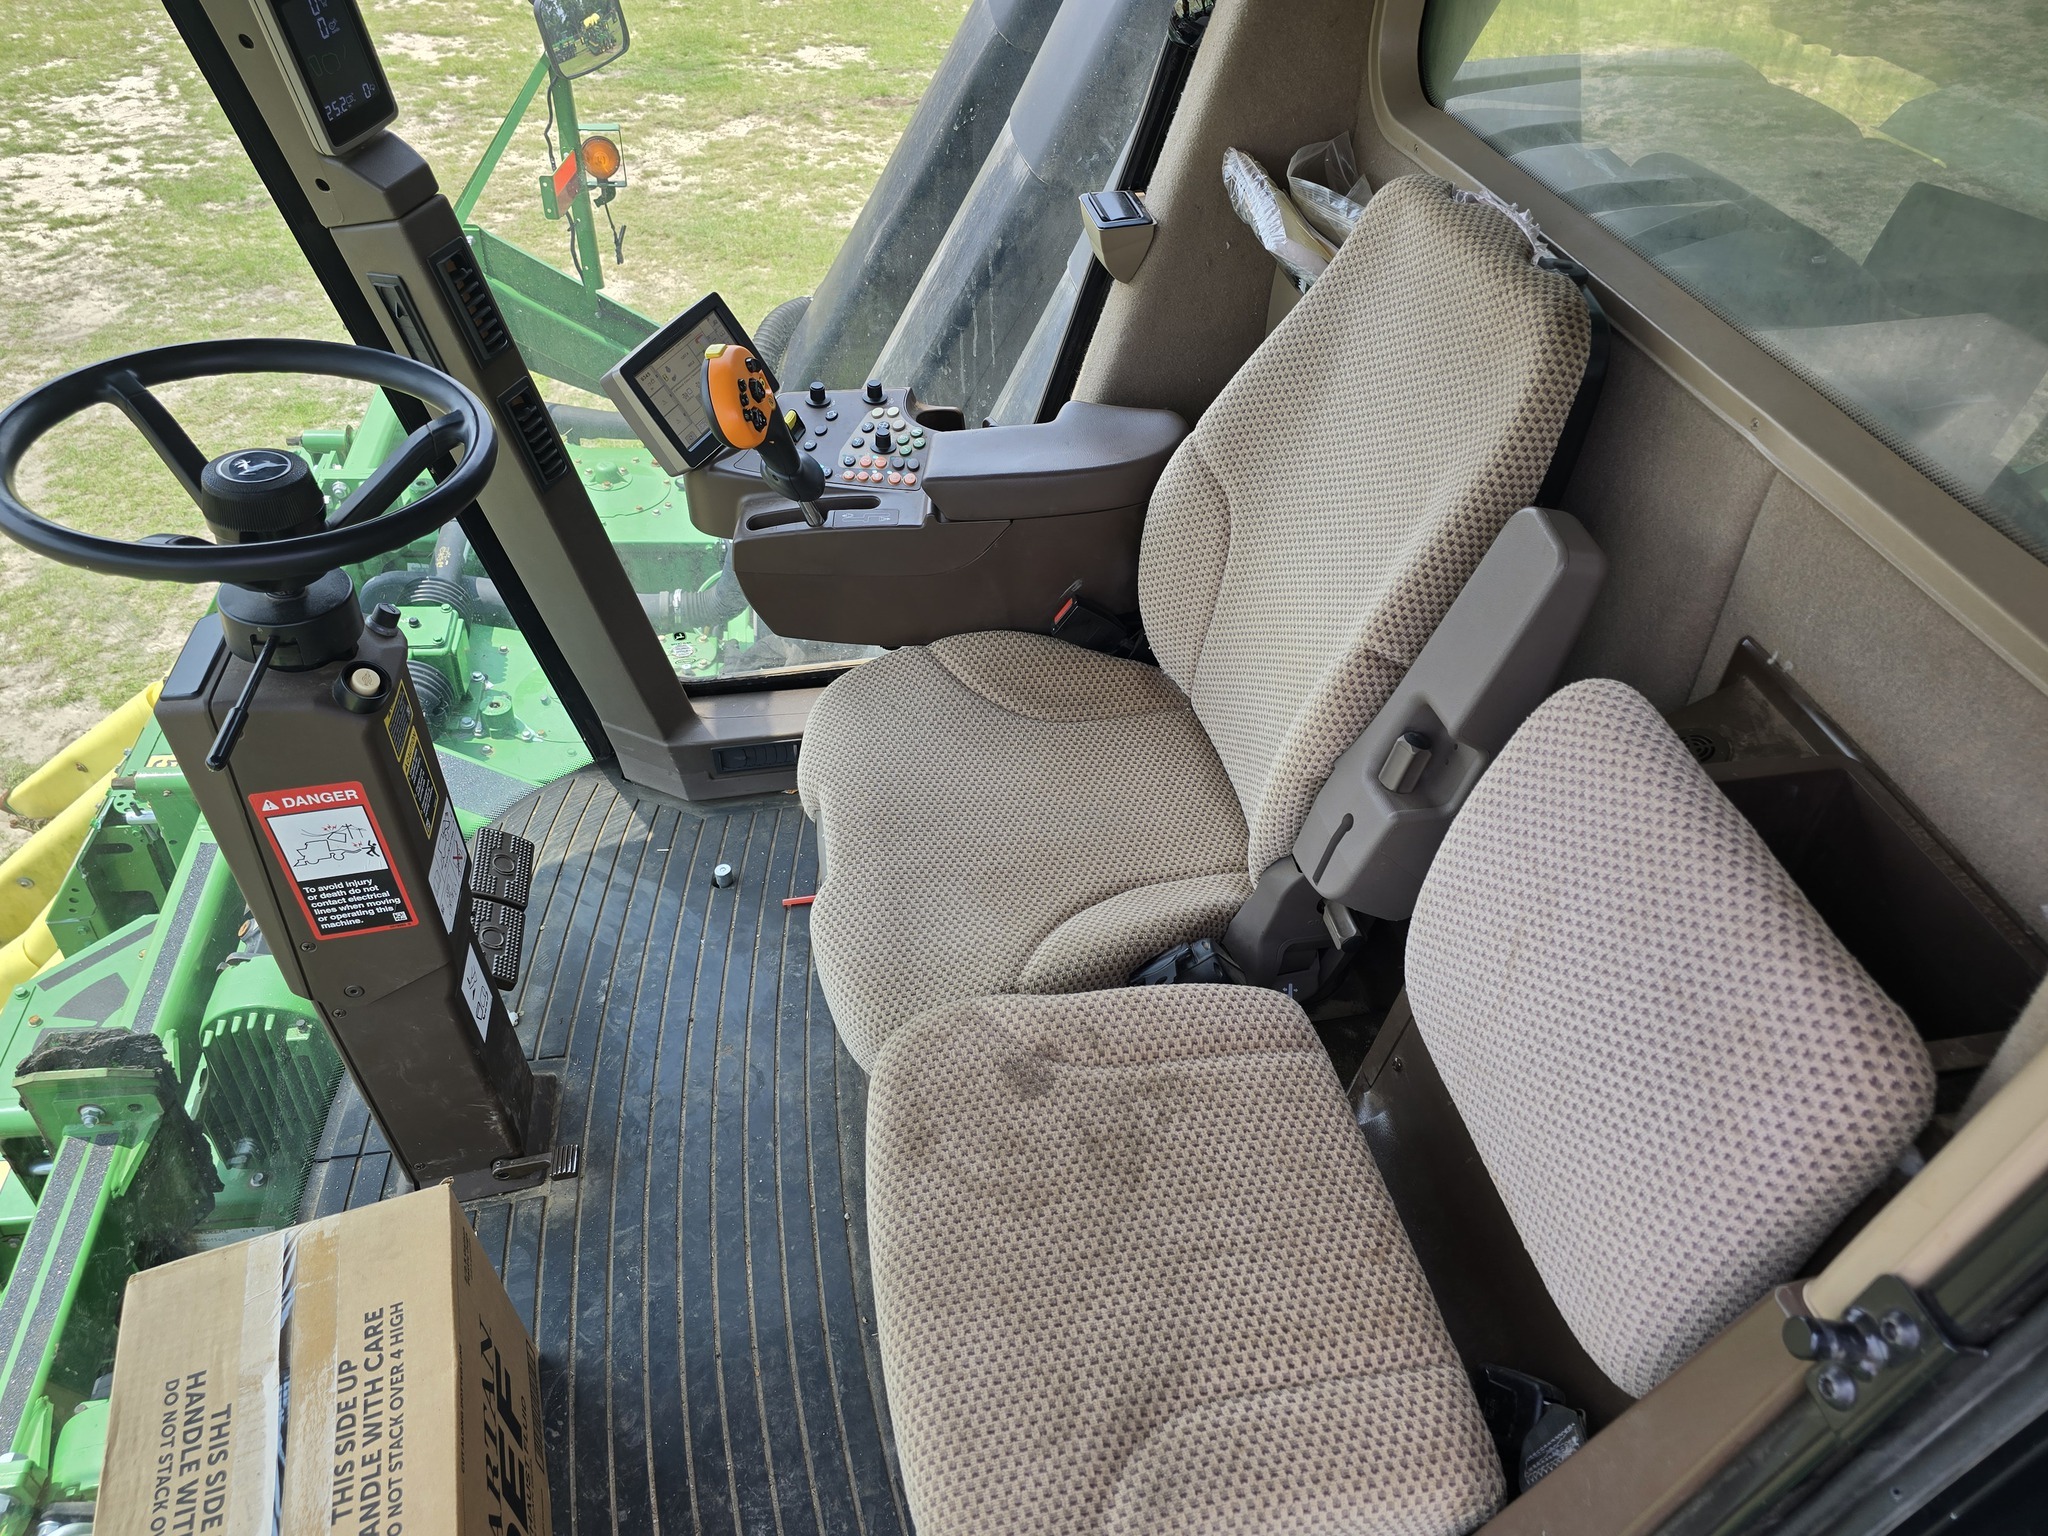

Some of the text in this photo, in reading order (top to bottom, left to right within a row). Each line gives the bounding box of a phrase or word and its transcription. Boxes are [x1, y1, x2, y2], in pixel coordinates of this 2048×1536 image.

[281, 789, 359, 809] DANGER
[302, 878, 373, 894] To avoid injury
[311, 890, 391, 909] contact electrical
[313, 897, 401, 916] lines when moving
[319, 889, 347, 900] death
[348, 887, 362, 895] do
[363, 884, 380, 893] not
[321, 918, 364, 930] machine.
[329, 907, 376, 920] operating
[376, 904, 394, 914] this
[364, 1307, 384, 1372] CARE
[390, 1301, 404, 1347] HIGH
[390, 1348, 404, 1359] 4
[163, 1378, 180, 1406] DO
[389, 1362, 404, 1411] OVER
[160, 1409, 178, 1448] NOT
[362, 1376, 384, 1448] WITH
[520, 1395, 529, 1454] FLUID
[172, 1370, 207, 1536] HANDLE WIT
[331, 1360, 358, 1526] THIS SIDE UP
[388, 1412, 404, 1473] STACK
[152, 1452, 174, 1514] STACK
[200, 1403, 232, 1533] THIS SIDE
[387, 1477, 403, 1519] NOT
[524, 1455, 535, 1536] HAUST
